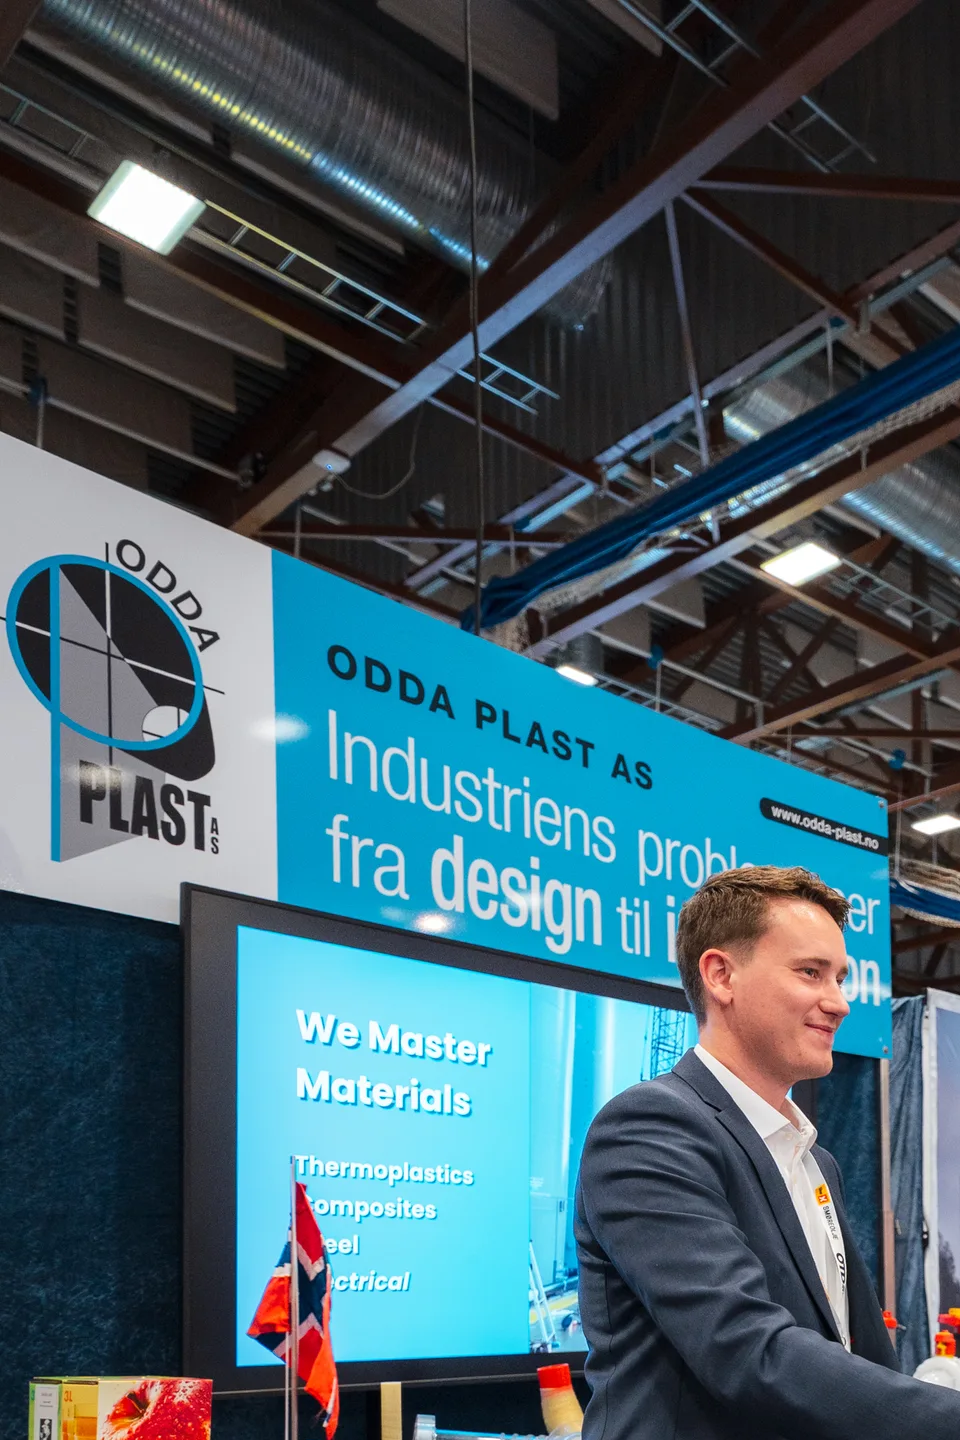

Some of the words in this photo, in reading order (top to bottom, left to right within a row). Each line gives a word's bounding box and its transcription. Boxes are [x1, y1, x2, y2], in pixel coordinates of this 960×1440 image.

[115, 538, 221, 652] ODDA
[327, 645, 456, 720] ODDA
[475, 699, 595, 769] PLAST
[611, 753, 654, 790] AS
[79, 760, 212, 852] PLAST
[328, 709, 617, 864] Industriens
[770, 805, 880, 850] www.odda-plast.no
[325, 813, 410, 901] fra
[430, 834, 603, 955] design
[616, 896, 651, 958] til
[296, 1009, 361, 1049] We
[368, 1020, 493, 1066] Master
[296, 1067, 474, 1117] Materials
[295, 1155, 475, 1187] Thermoplastics
[324, 1234, 360, 1255] eel
